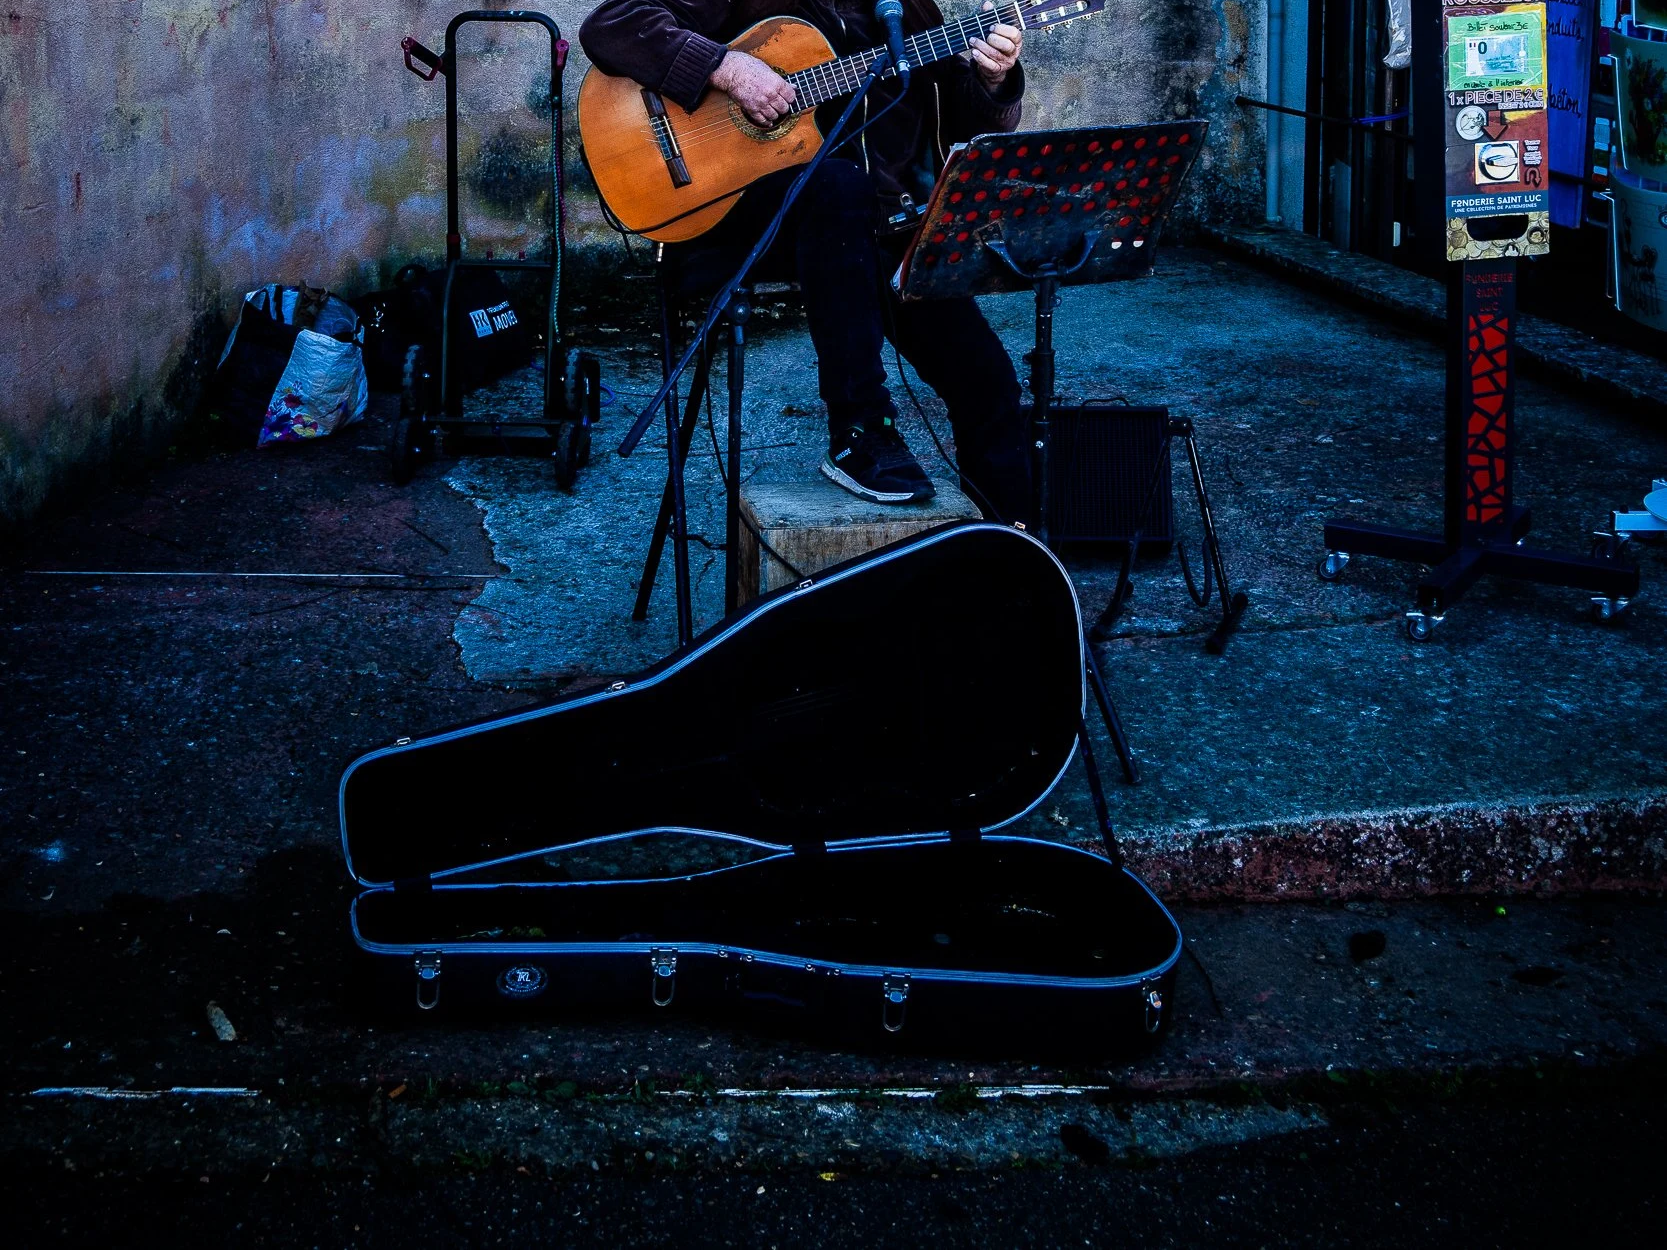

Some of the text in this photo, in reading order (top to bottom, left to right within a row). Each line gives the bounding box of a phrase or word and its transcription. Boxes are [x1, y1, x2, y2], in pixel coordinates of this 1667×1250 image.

[1478, 41, 1488, 54] 0
[1465, 90, 1502, 105] PIECE
[1503, 89, 1522, 103] DE
[1524, 88, 1533, 101] 2
[1451, 194, 1542, 208] FONDERIE SAINT LUC
